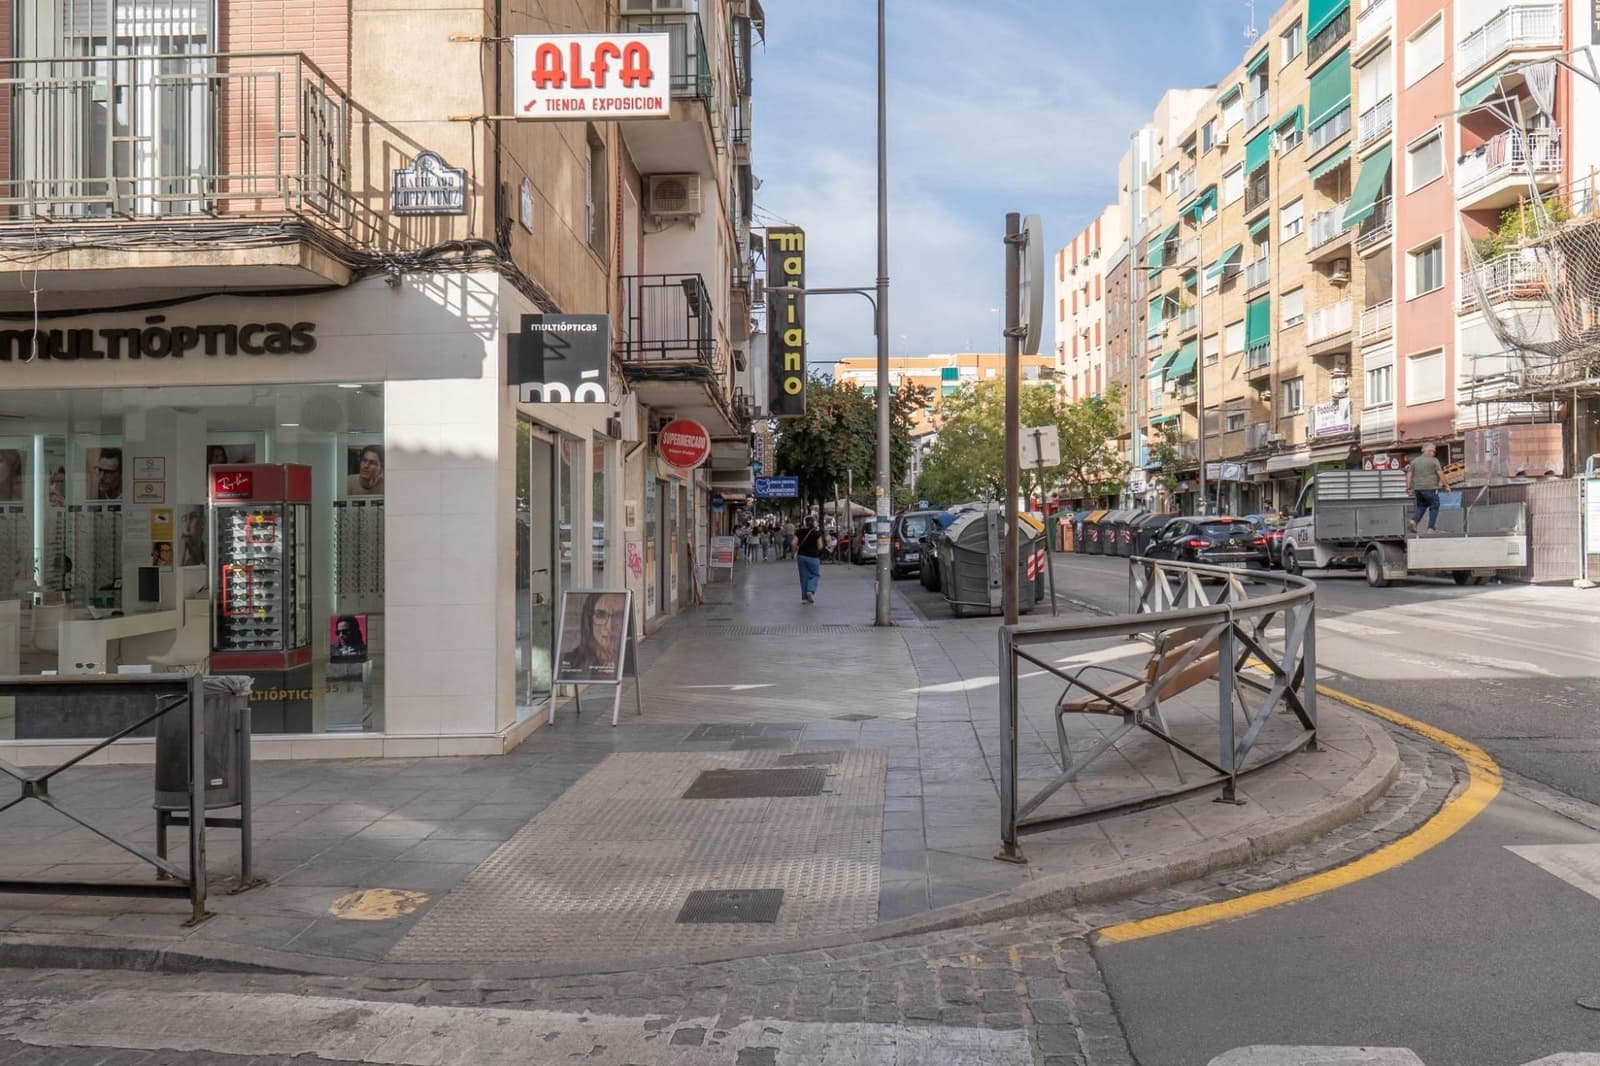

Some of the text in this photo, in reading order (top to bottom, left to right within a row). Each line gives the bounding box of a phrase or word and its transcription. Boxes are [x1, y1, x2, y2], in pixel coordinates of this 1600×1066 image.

[532, 41, 654, 89] ALFA
[545, 97, 662, 111] TIENDA EXPOSICION
[768, 233, 804, 395] mariano
[663, 431, 706, 449] SUPERMERCADO
